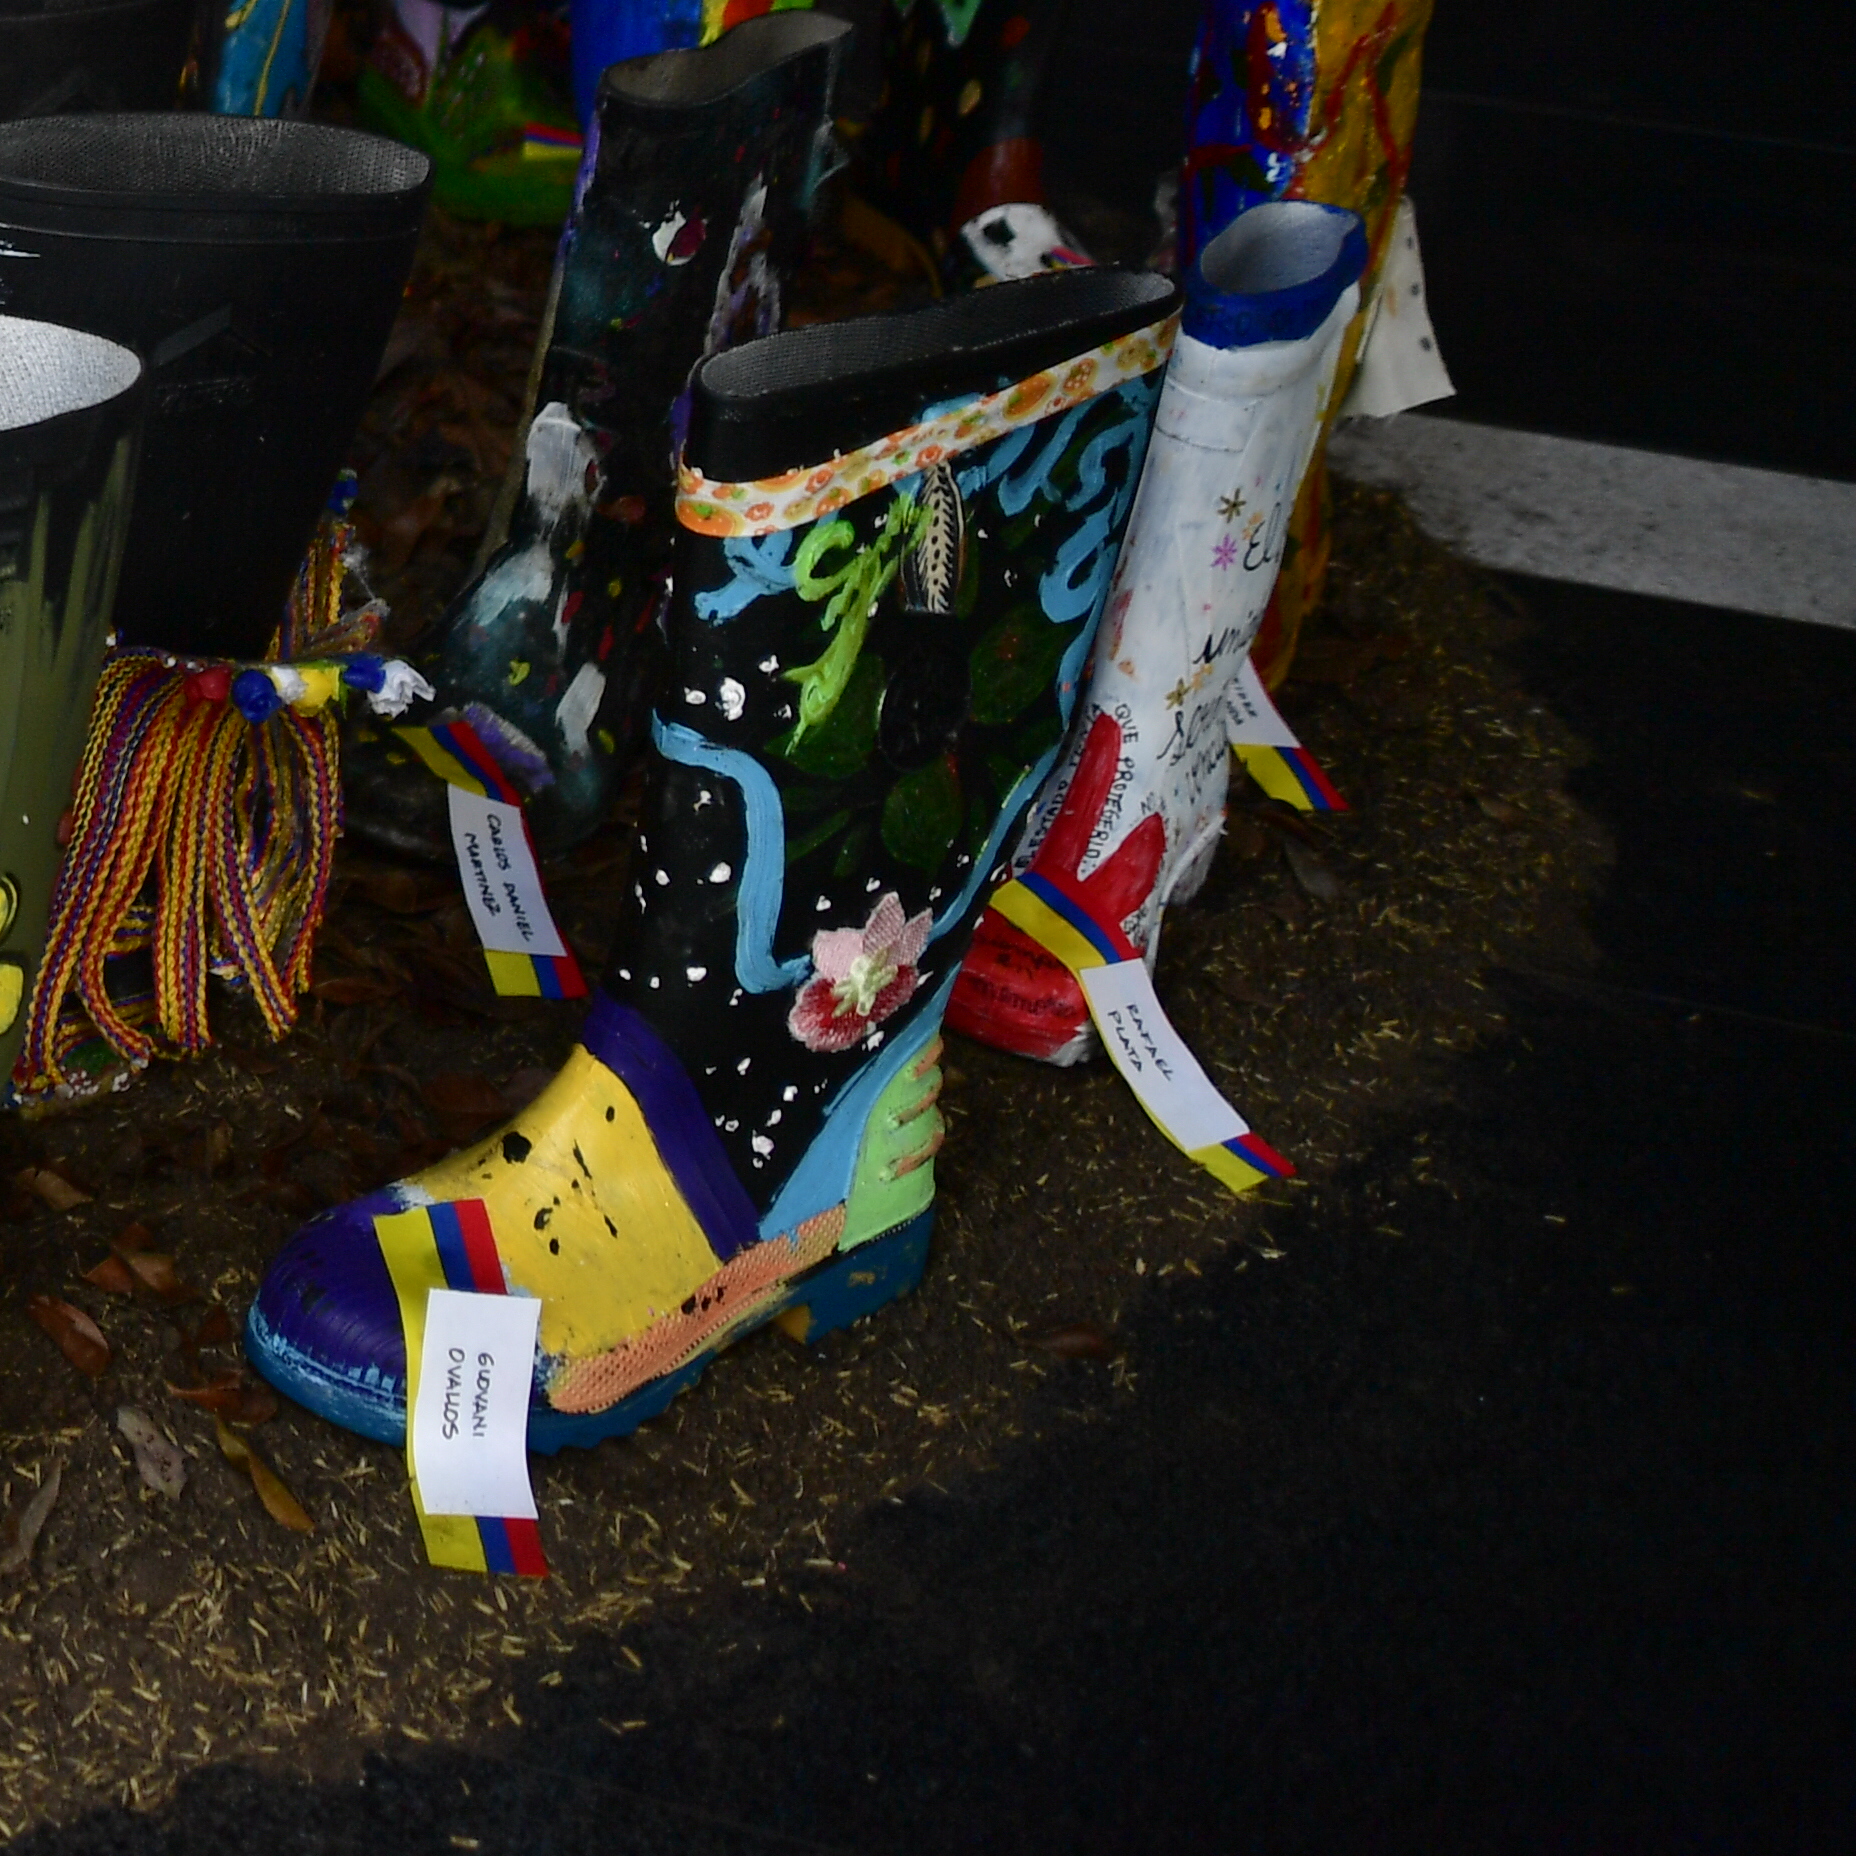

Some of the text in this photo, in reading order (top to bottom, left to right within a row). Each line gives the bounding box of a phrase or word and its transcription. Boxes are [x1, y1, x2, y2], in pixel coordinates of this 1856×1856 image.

[1114, 703, 1139, 744] QUE
[465, 832, 501, 917] MARTINEZ
[487, 814, 534, 942] CARLOS DANIEL
[1107, 1010, 1143, 1073] PLATA
[1126, 1004, 1174, 1082] RAFAEL
[442, 1348, 466, 1441] OVALLOS
